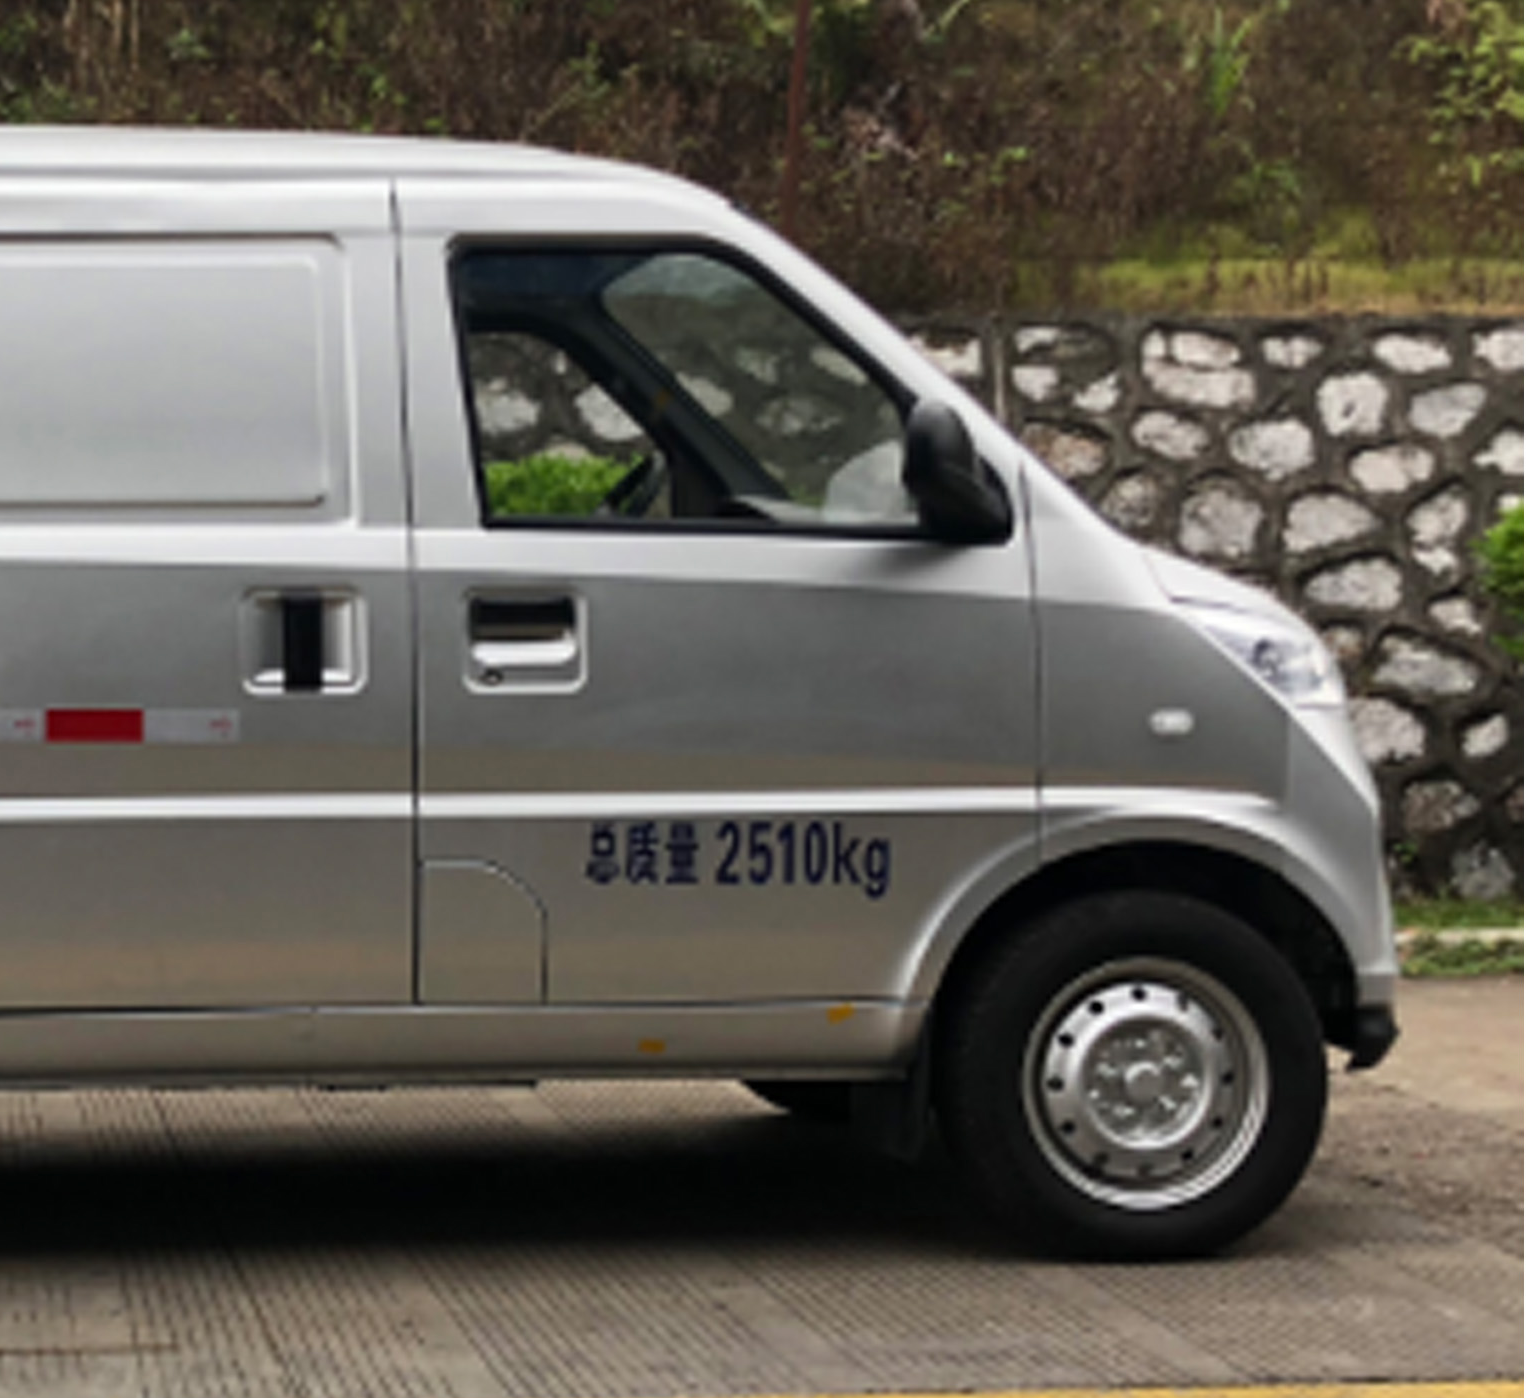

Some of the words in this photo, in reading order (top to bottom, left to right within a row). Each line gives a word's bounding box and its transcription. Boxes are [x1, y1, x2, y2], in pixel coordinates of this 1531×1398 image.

[585, 820, 700, 884] 总质量
[714, 820, 891, 899] 2510kg
